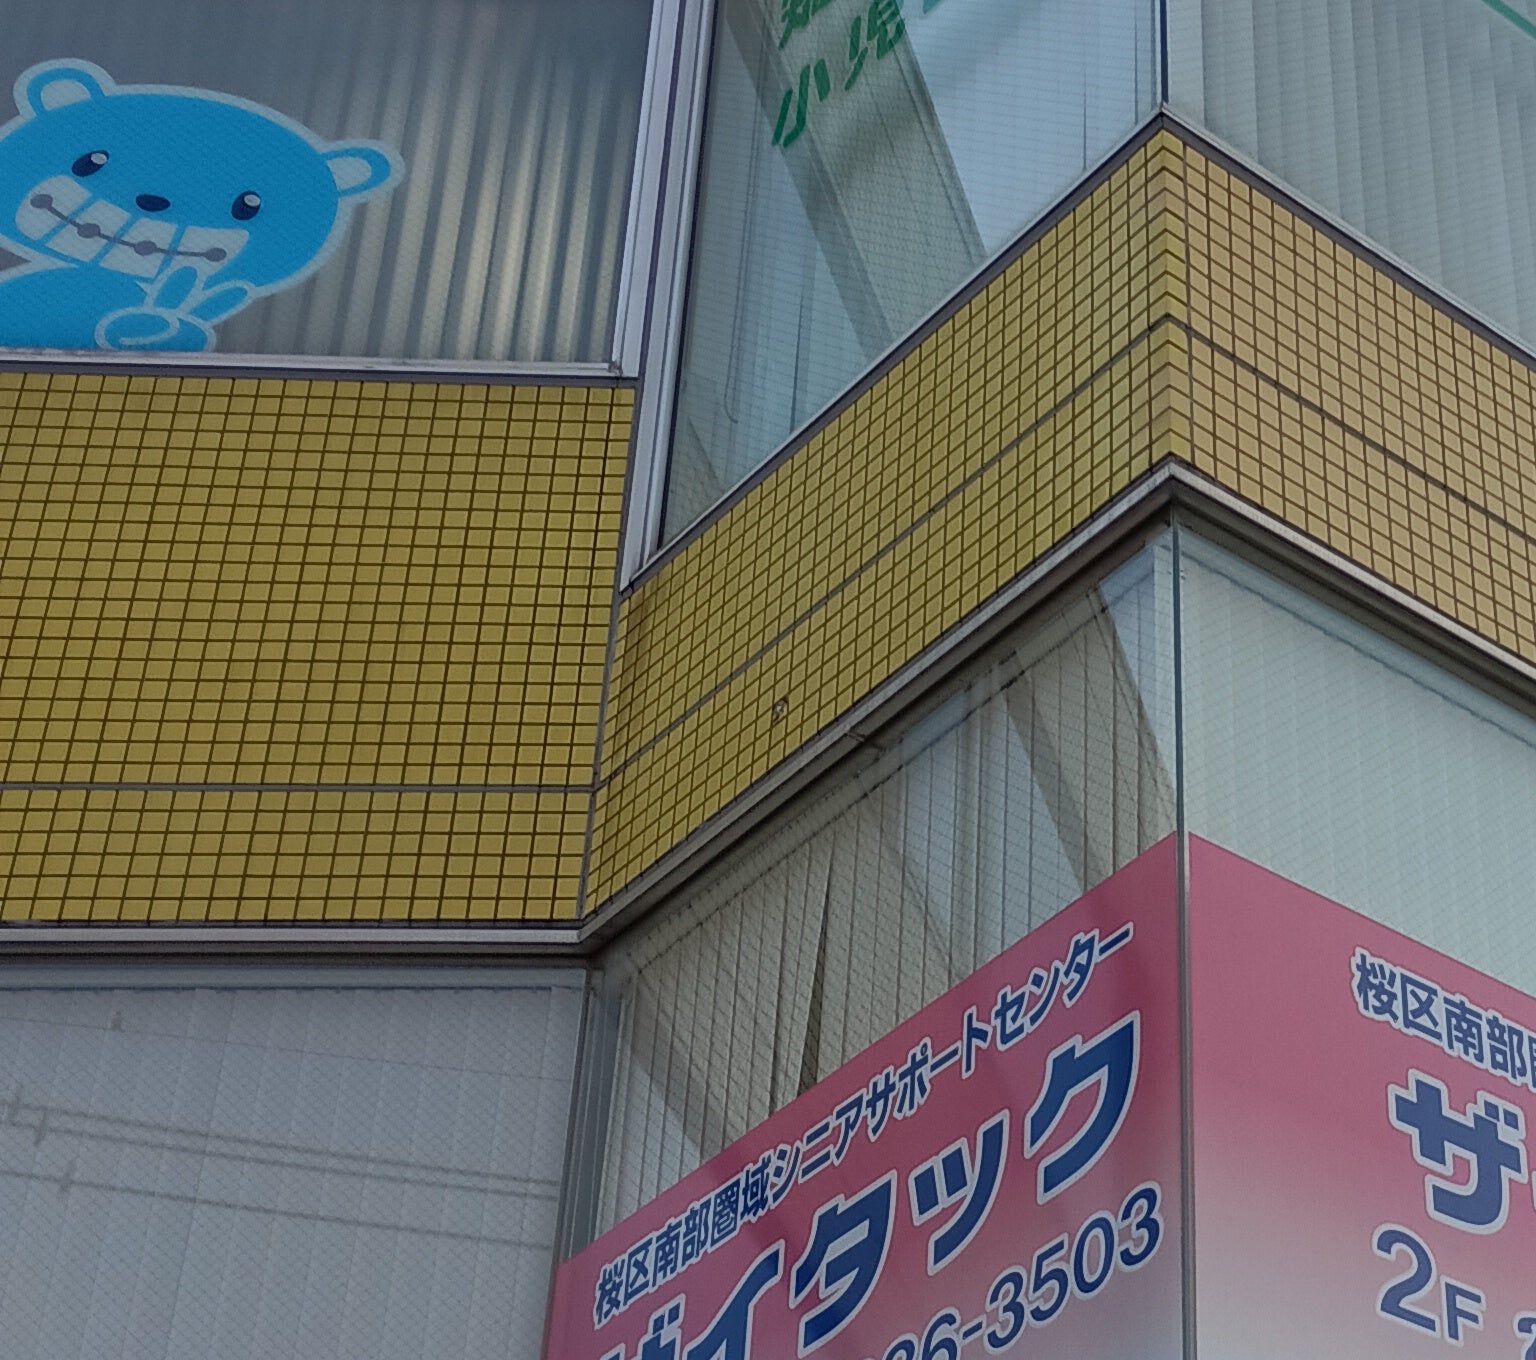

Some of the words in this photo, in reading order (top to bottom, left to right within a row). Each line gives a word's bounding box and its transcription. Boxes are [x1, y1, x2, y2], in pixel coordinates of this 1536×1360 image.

[596, 922, 1135, 1327] 桜区南部圏域シニアサポートセンター
[1372, 1226, 1485, 1344] 2F
